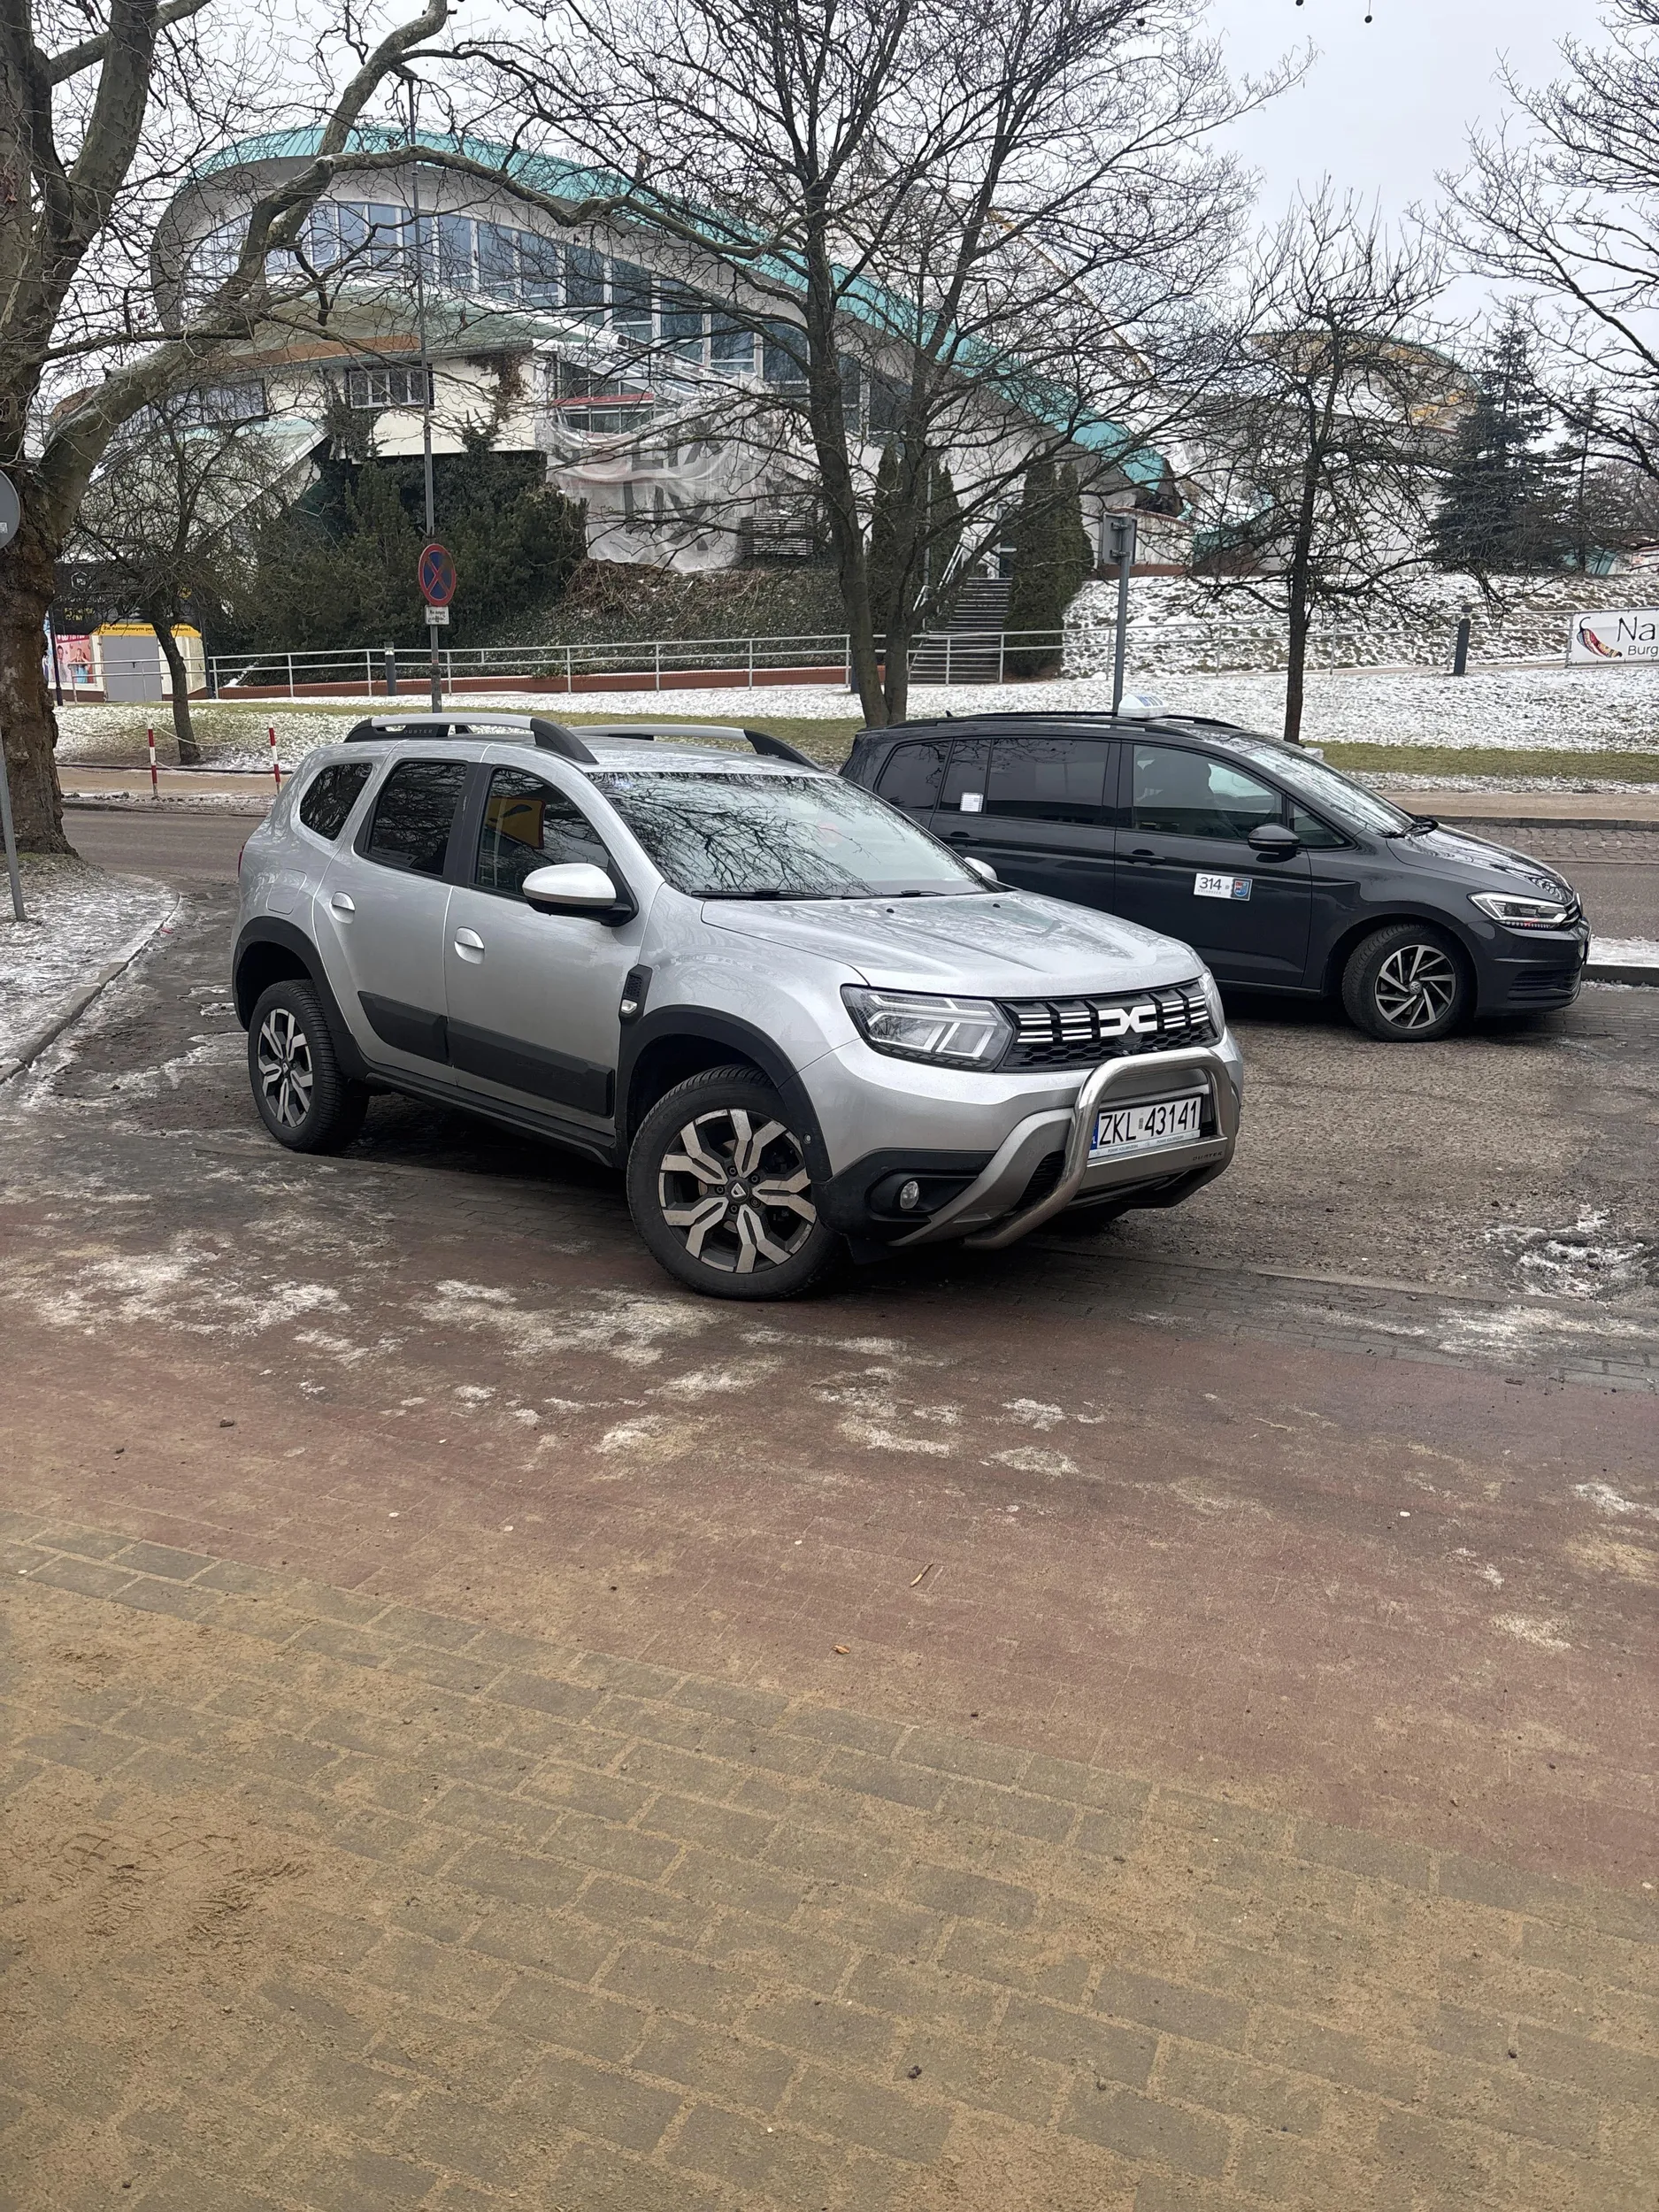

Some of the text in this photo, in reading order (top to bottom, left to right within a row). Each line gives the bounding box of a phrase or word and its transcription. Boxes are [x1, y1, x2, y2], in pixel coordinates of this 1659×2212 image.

[1617, 616, 1656, 641] Na
[1628, 645, 1659, 657] Burg
[1199, 877, 1222, 890] 314
[1099, 1101, 1197, 1146] ZKL 43141
